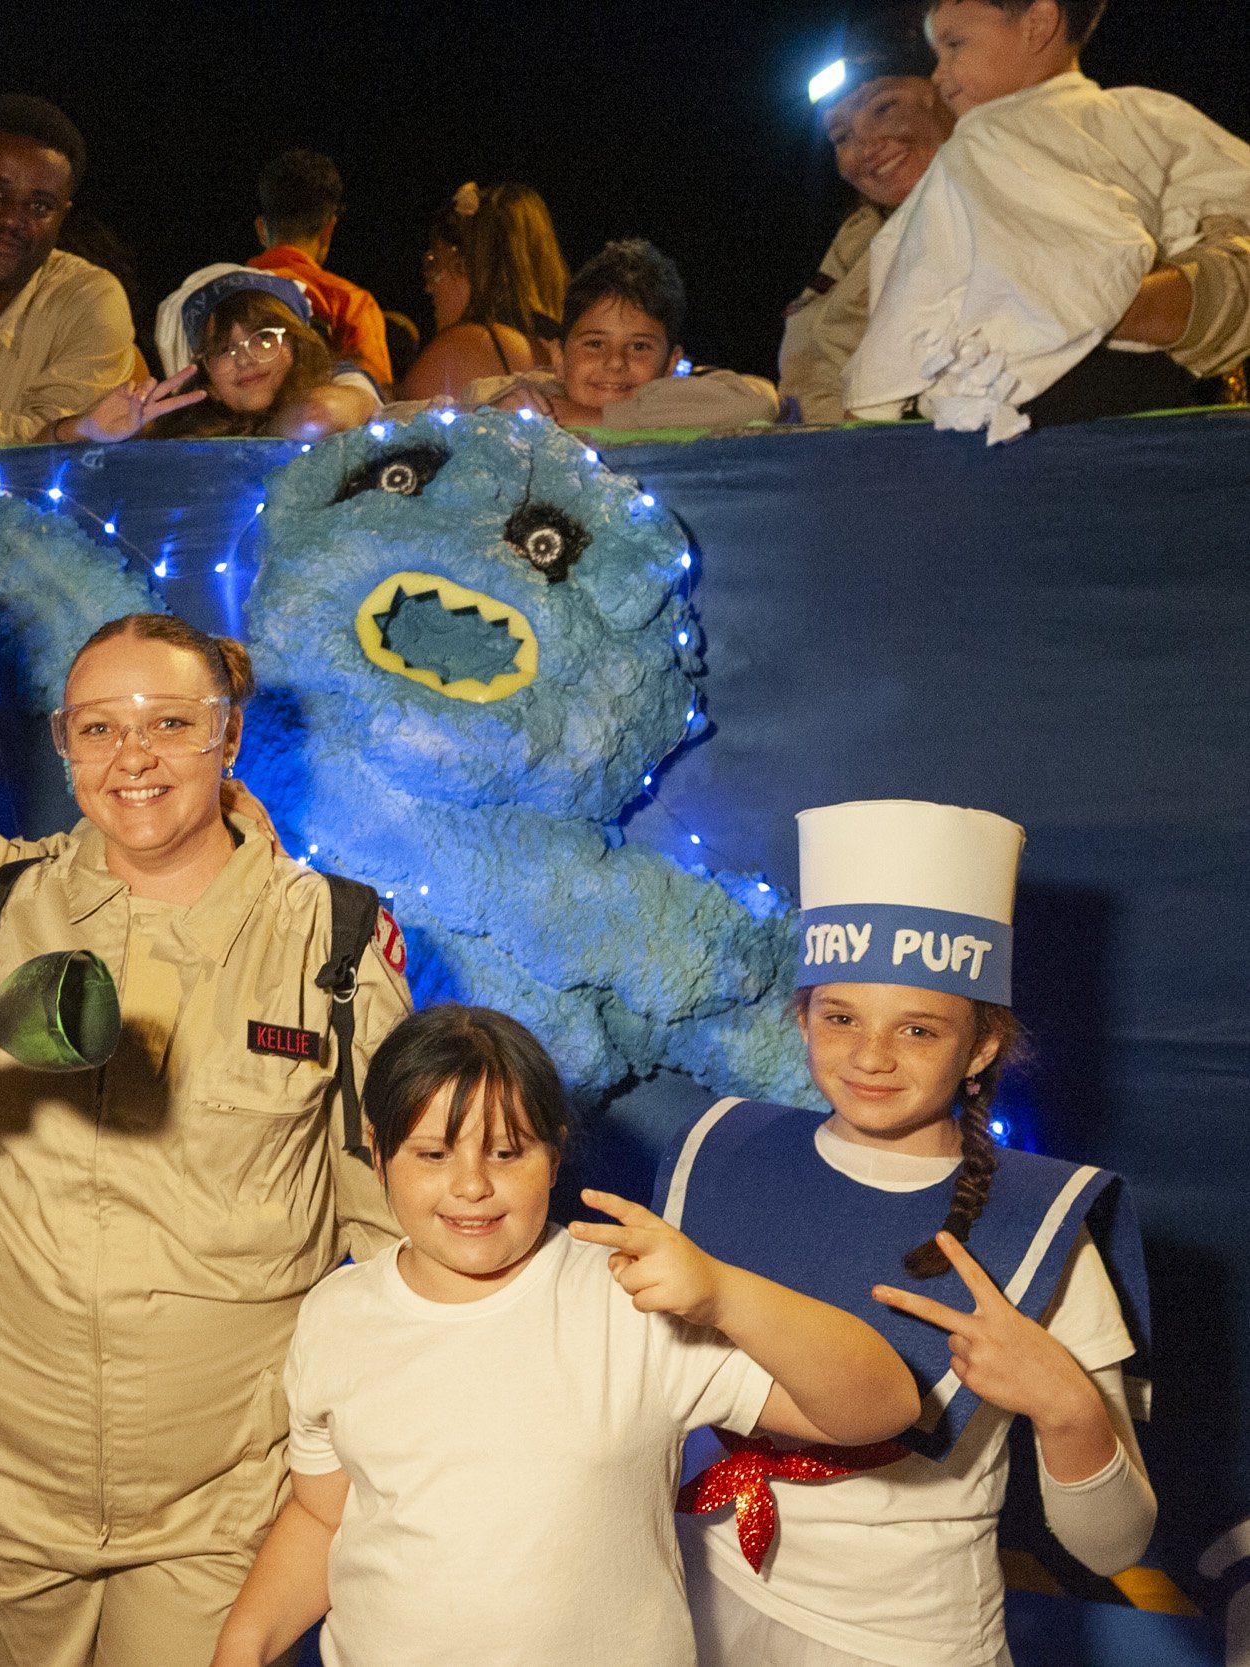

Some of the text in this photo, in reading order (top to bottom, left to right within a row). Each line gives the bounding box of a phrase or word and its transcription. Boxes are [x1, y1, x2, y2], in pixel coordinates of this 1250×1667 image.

[804, 922, 993, 981] STAY PUFT
[256, 1025, 311, 1055] KELLIE
